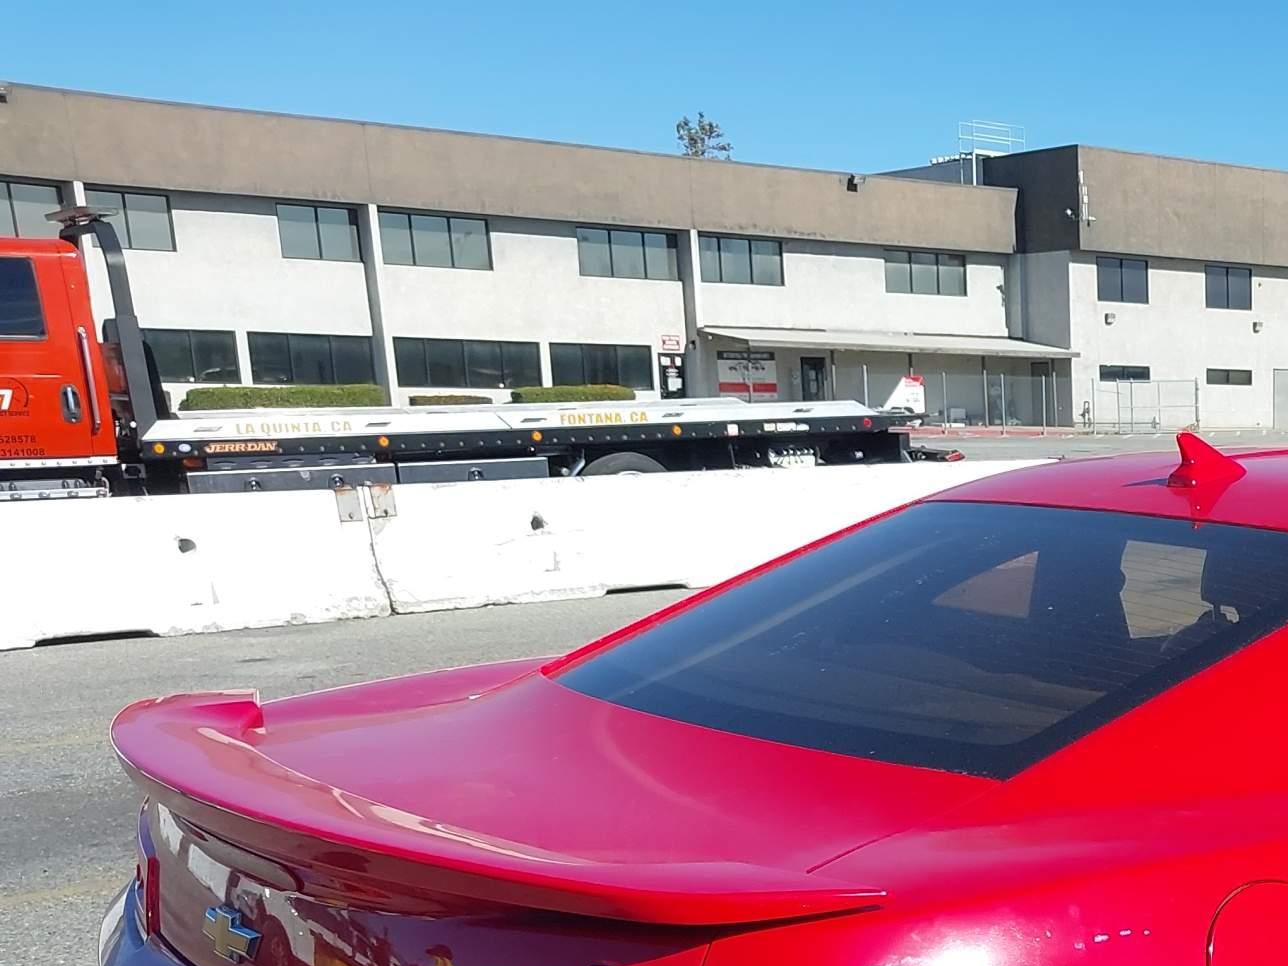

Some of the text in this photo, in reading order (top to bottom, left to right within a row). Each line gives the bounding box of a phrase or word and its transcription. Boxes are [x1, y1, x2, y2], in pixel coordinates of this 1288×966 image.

[630, 410, 649, 423] CA
[236, 423, 255, 434] LA
[331, 420, 352, 432] CA
